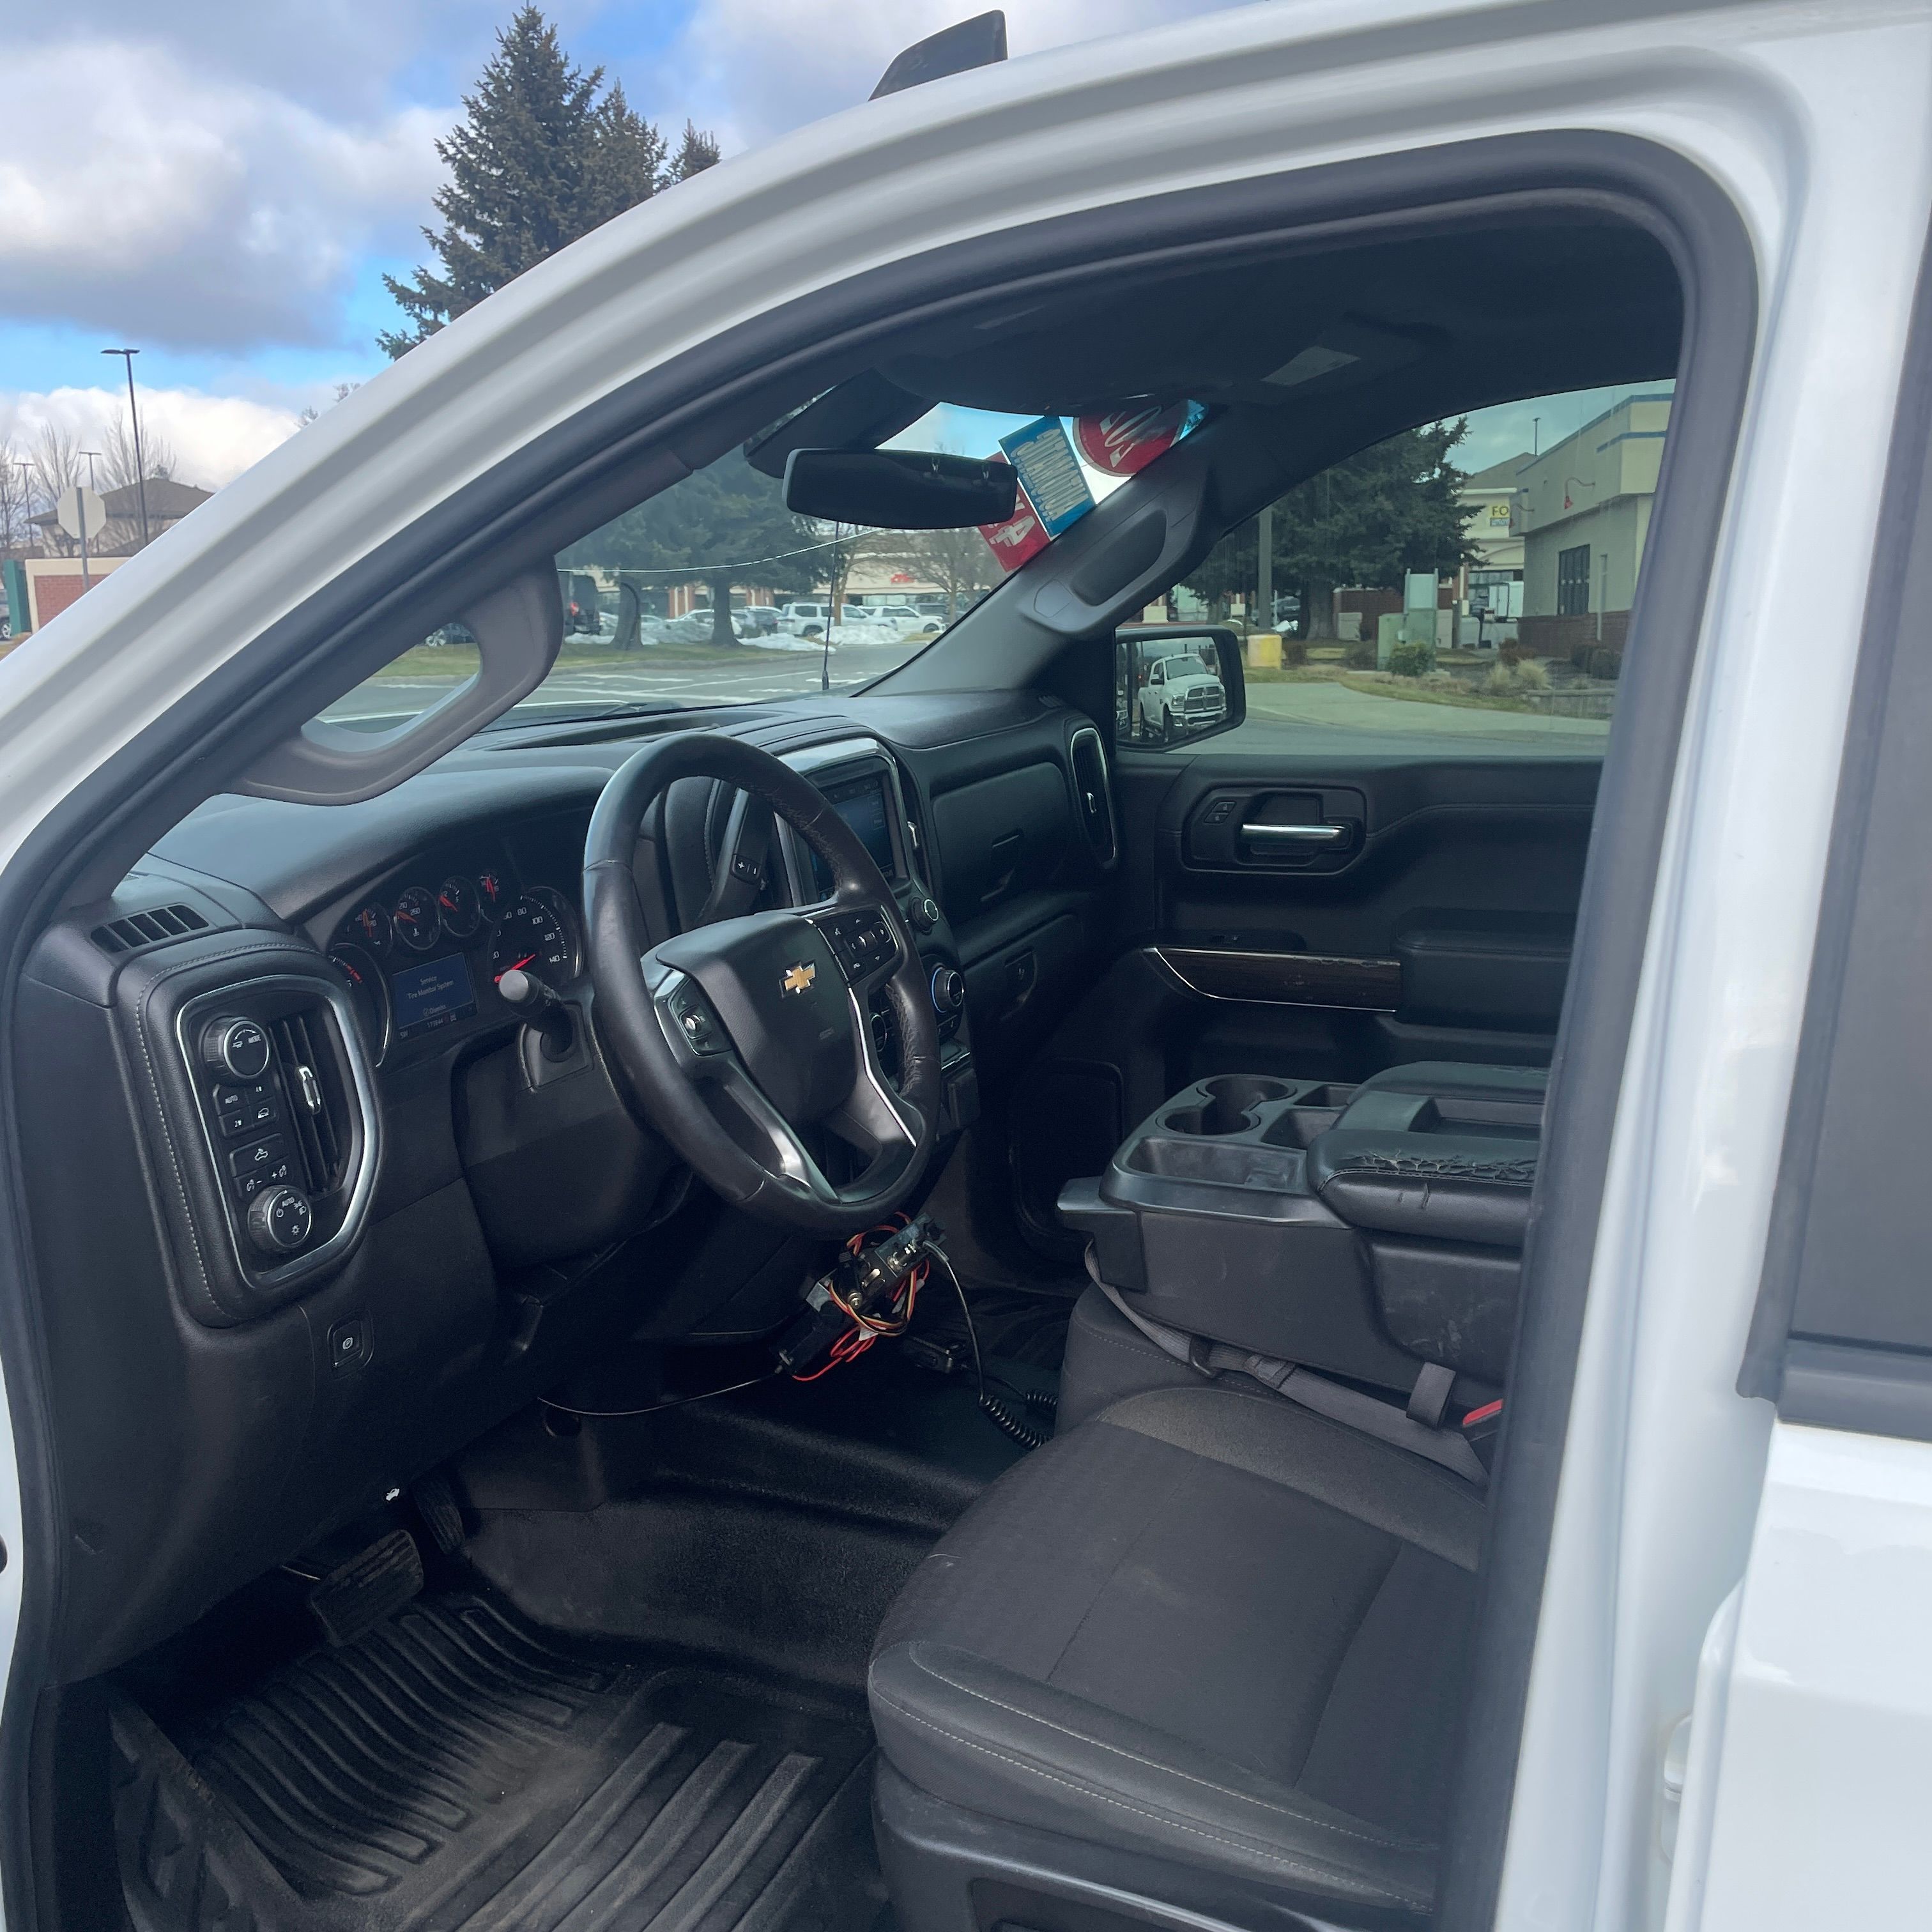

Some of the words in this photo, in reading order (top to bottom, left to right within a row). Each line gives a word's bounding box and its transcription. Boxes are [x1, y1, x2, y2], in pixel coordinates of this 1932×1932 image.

[517, 907, 527, 916] 80
[532, 916, 543, 925] 100
[420, 976, 437, 985] Service
[407, 991, 418, 1000] Tire
[417, 986, 436, 997] Monitor
[436, 980, 454, 991] System
[225, 1094, 238, 1104] AUTO
[282, 1197, 295, 1208] AUTO
